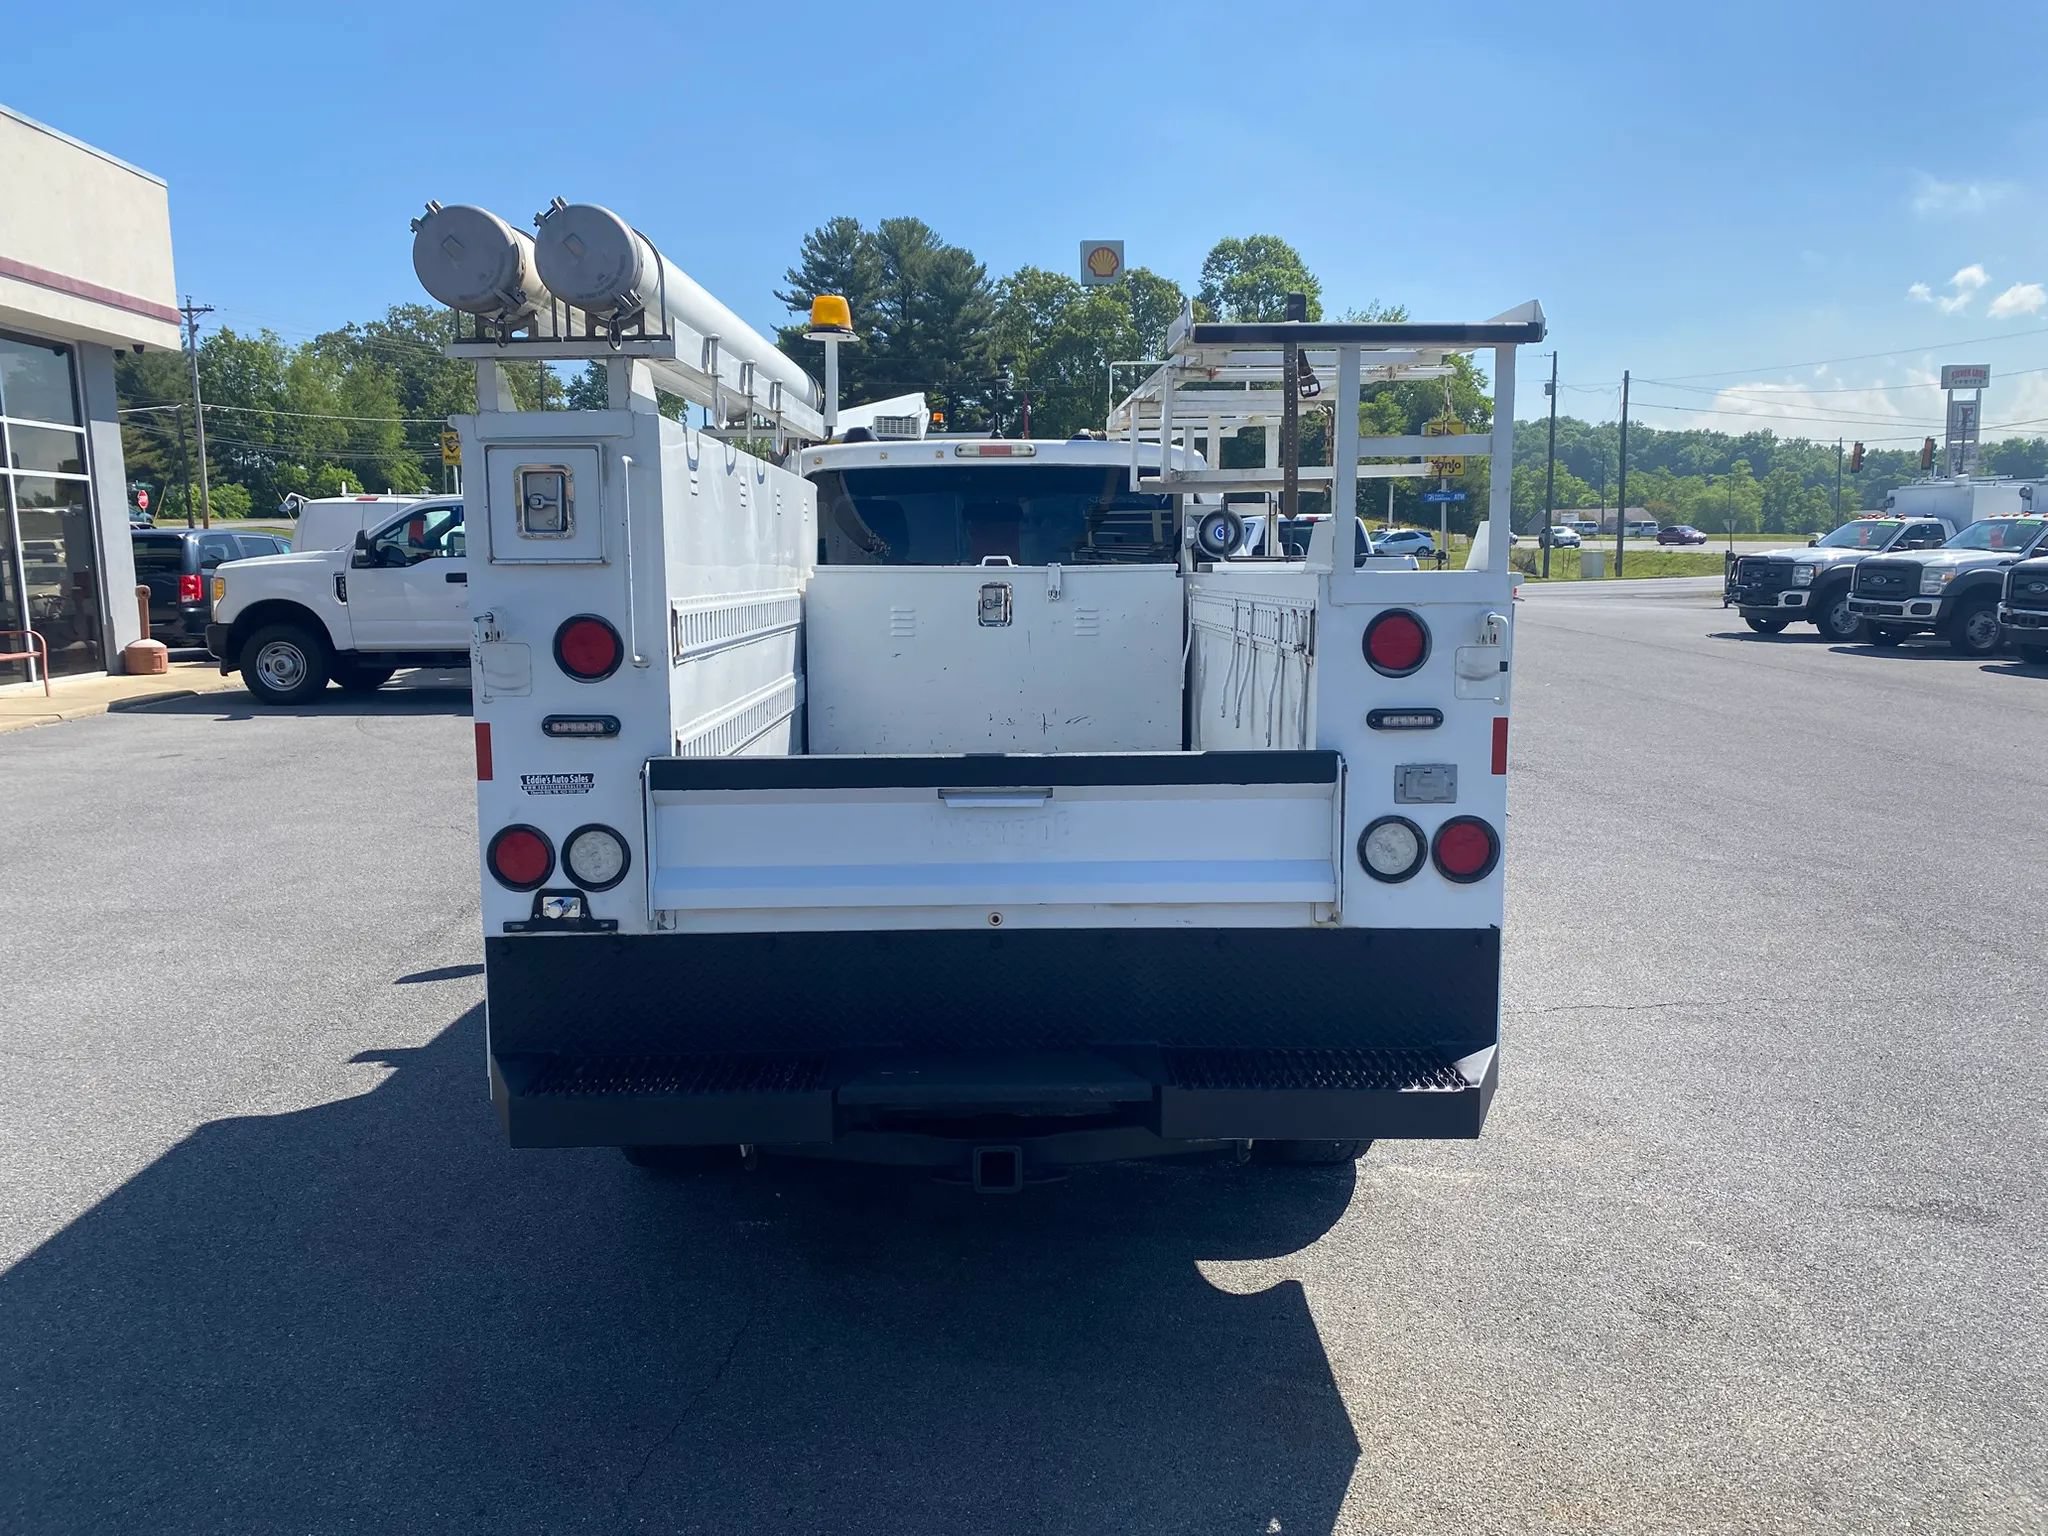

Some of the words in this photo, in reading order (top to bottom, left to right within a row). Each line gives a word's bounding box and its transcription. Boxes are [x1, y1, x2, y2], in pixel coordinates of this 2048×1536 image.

[526, 775, 551, 785] Eddie's
[552, 774, 569, 784] Auto
[569, 774, 589, 783] Sales
